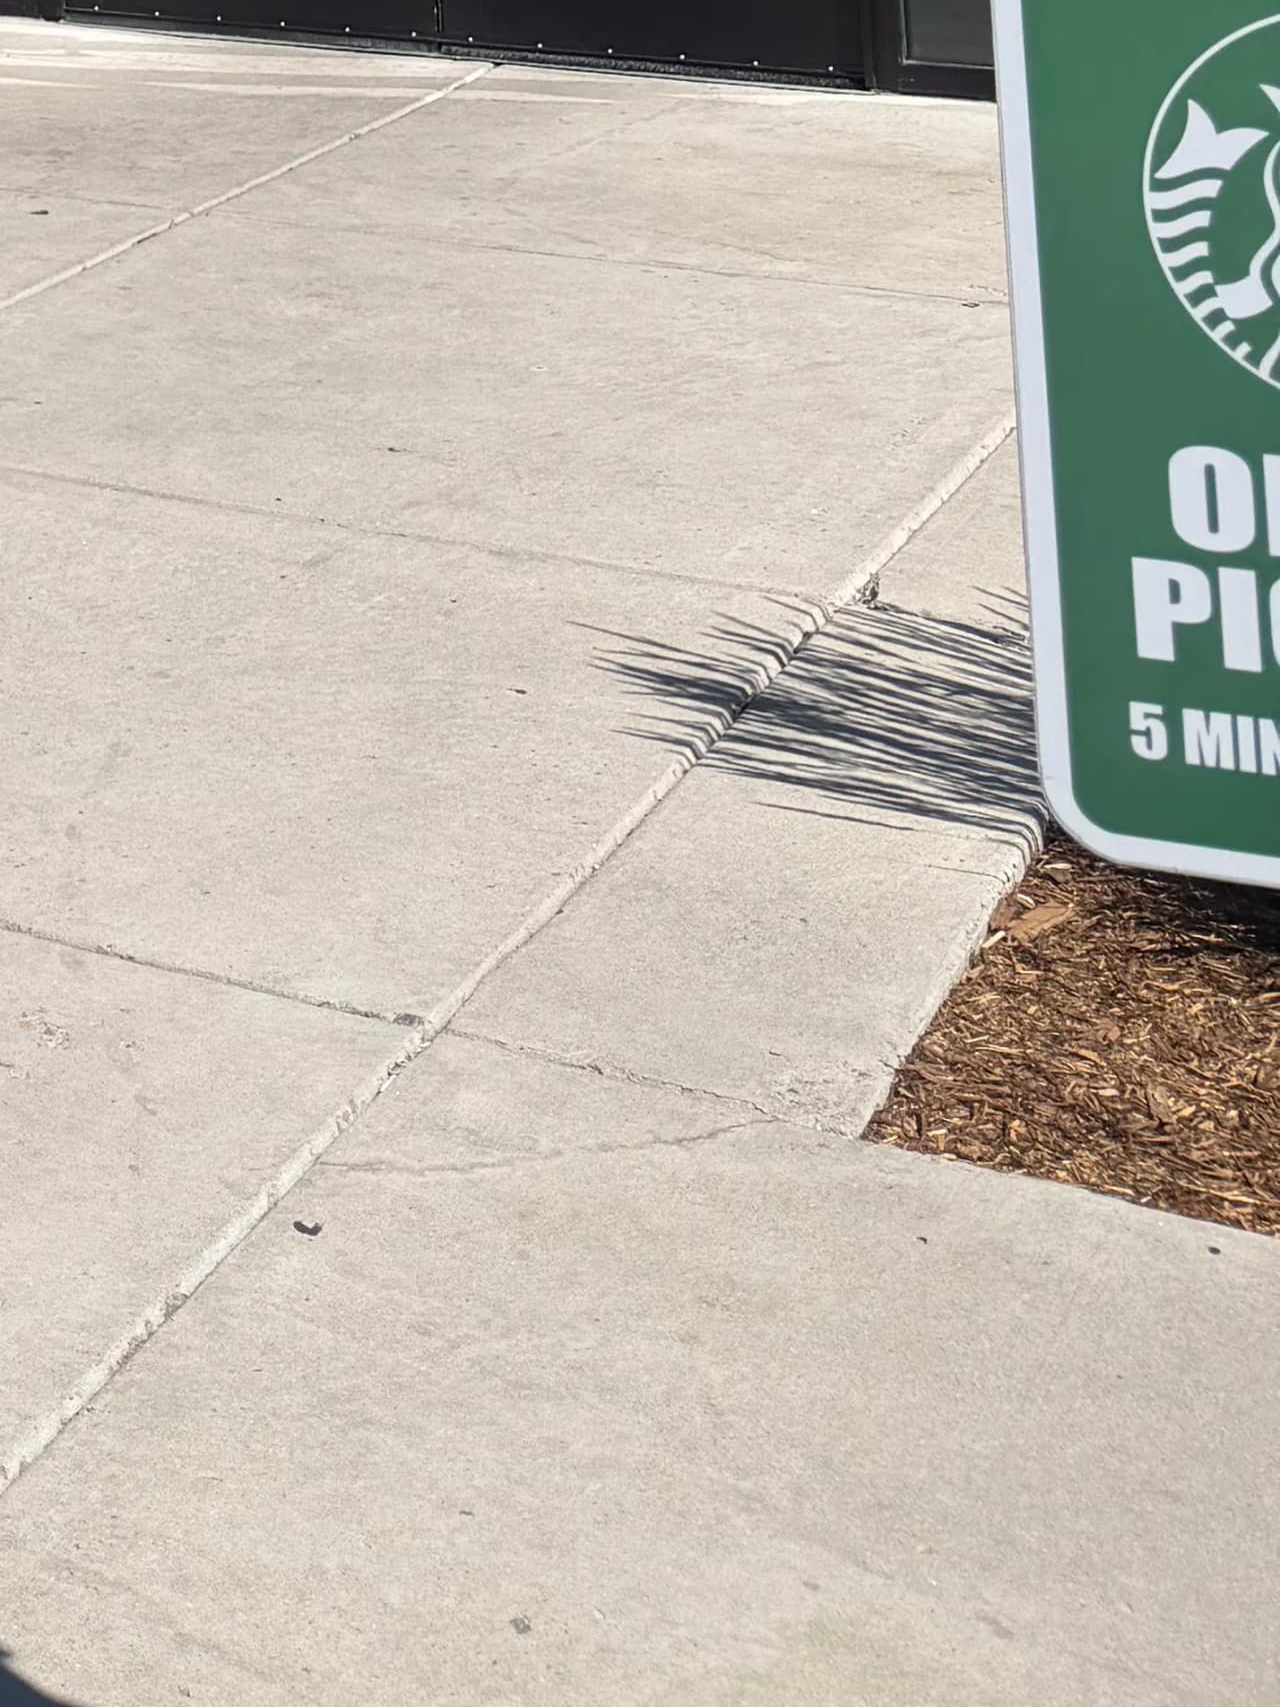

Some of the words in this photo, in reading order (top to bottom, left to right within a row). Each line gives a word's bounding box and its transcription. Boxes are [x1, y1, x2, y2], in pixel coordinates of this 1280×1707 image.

[1168, 445, 1280, 557] O
[1131, 556, 1280, 673] PI
[1128, 701, 1169, 761] 5
